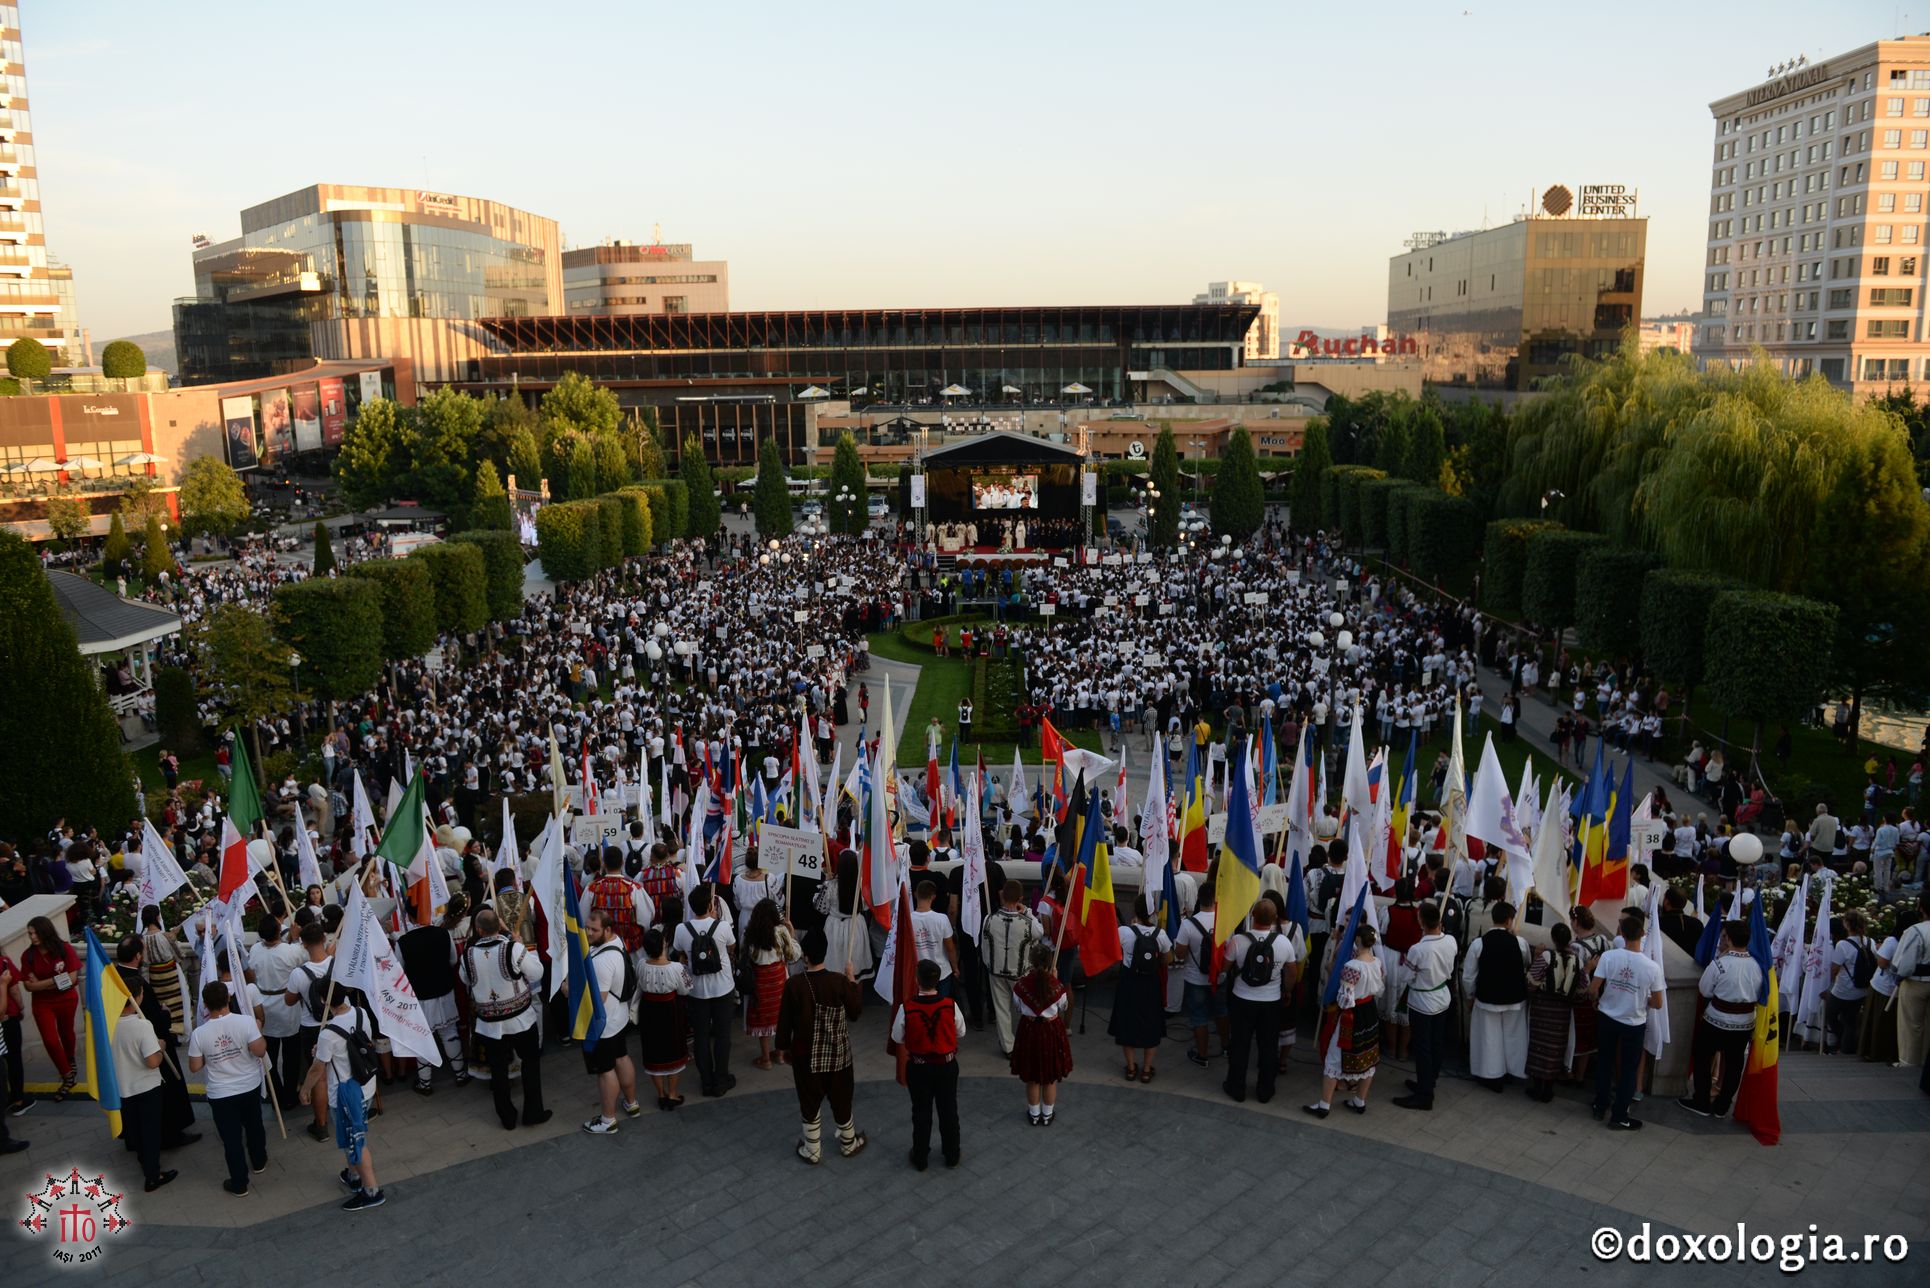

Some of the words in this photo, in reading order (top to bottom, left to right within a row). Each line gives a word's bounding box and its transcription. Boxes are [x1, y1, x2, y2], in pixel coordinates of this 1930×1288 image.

[1744, 64, 1827, 107] INTERNATIONAL
[1584, 185, 1625, 194] UNITED
[1584, 195, 1636, 204] BUSINESS
[1583, 206, 1626, 215] CENTER
[1293, 330, 1417, 355] Auchan
[603, 827, 617, 838] 59
[1646, 833, 1660, 844] 38
[798, 854, 817, 869] 48
[397, 1001, 418, 1010] 2017
